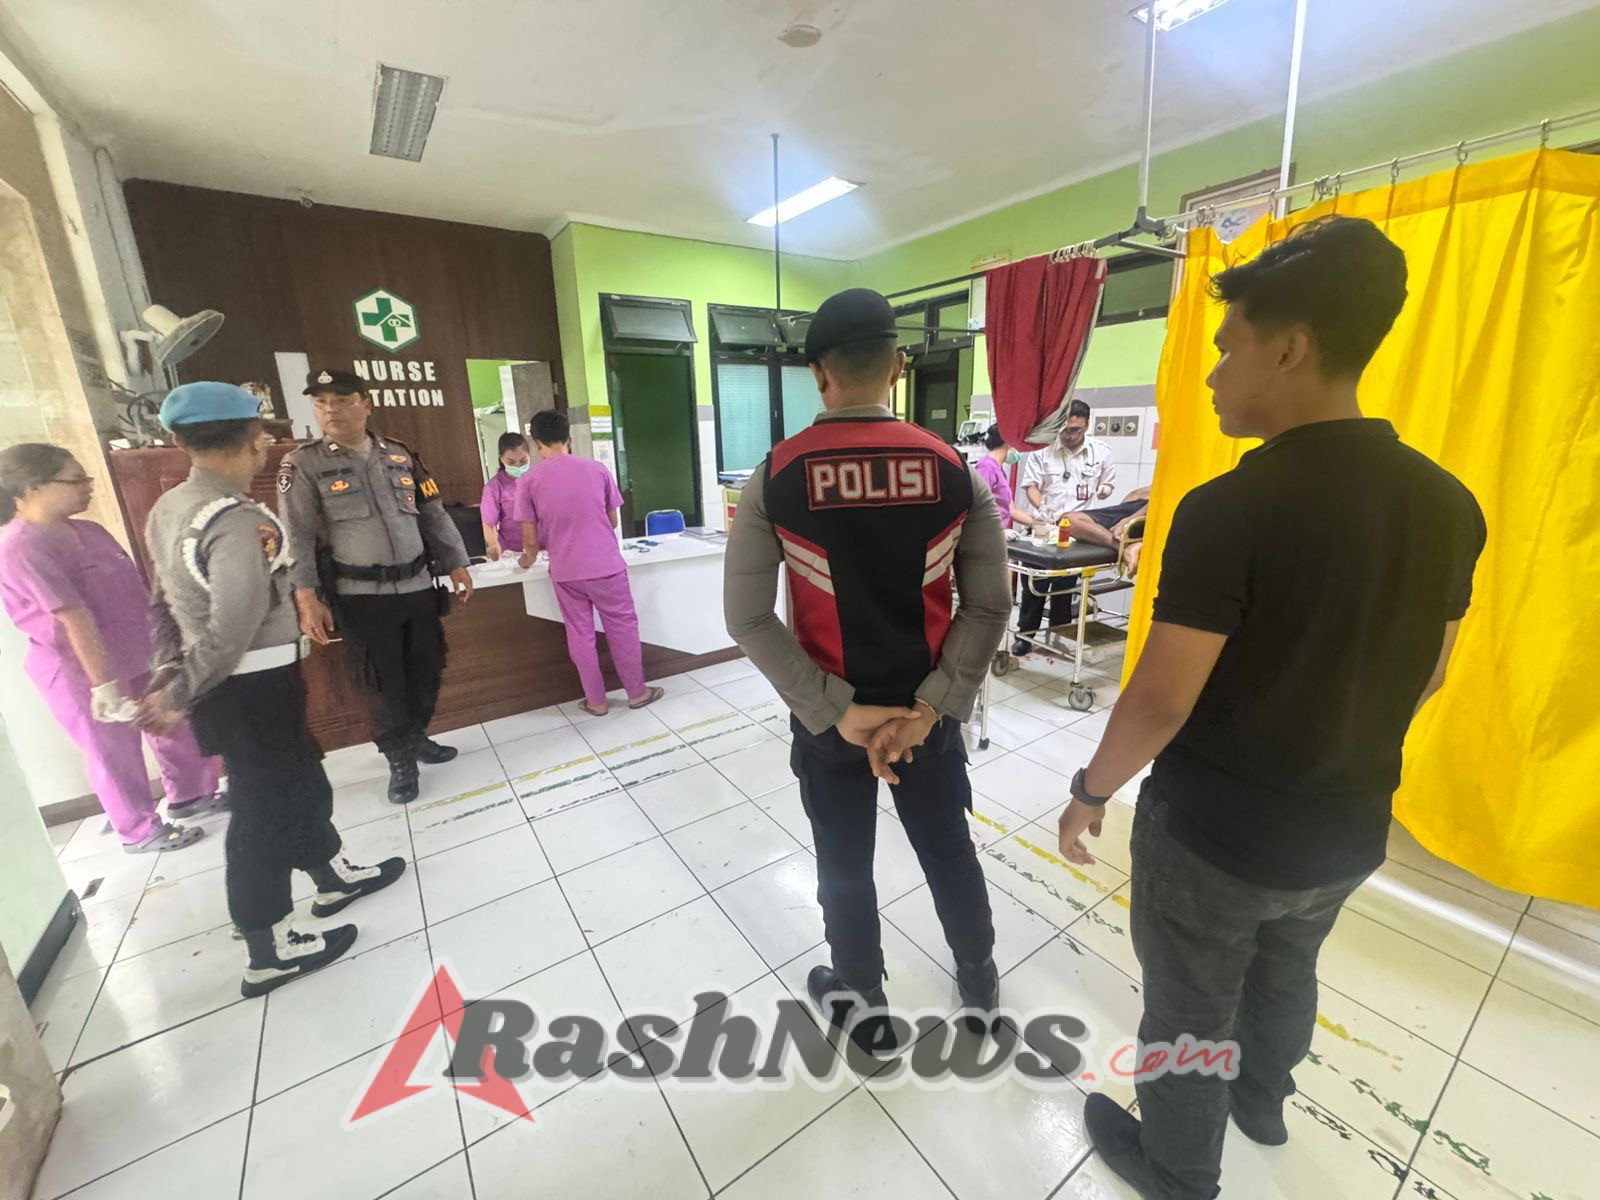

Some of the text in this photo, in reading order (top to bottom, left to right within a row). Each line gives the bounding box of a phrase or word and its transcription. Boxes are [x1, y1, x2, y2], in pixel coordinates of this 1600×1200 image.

[353, 360, 436, 382] NURSE
[367, 389, 444, 407] TATION
[811, 458, 936, 502] POLISI
